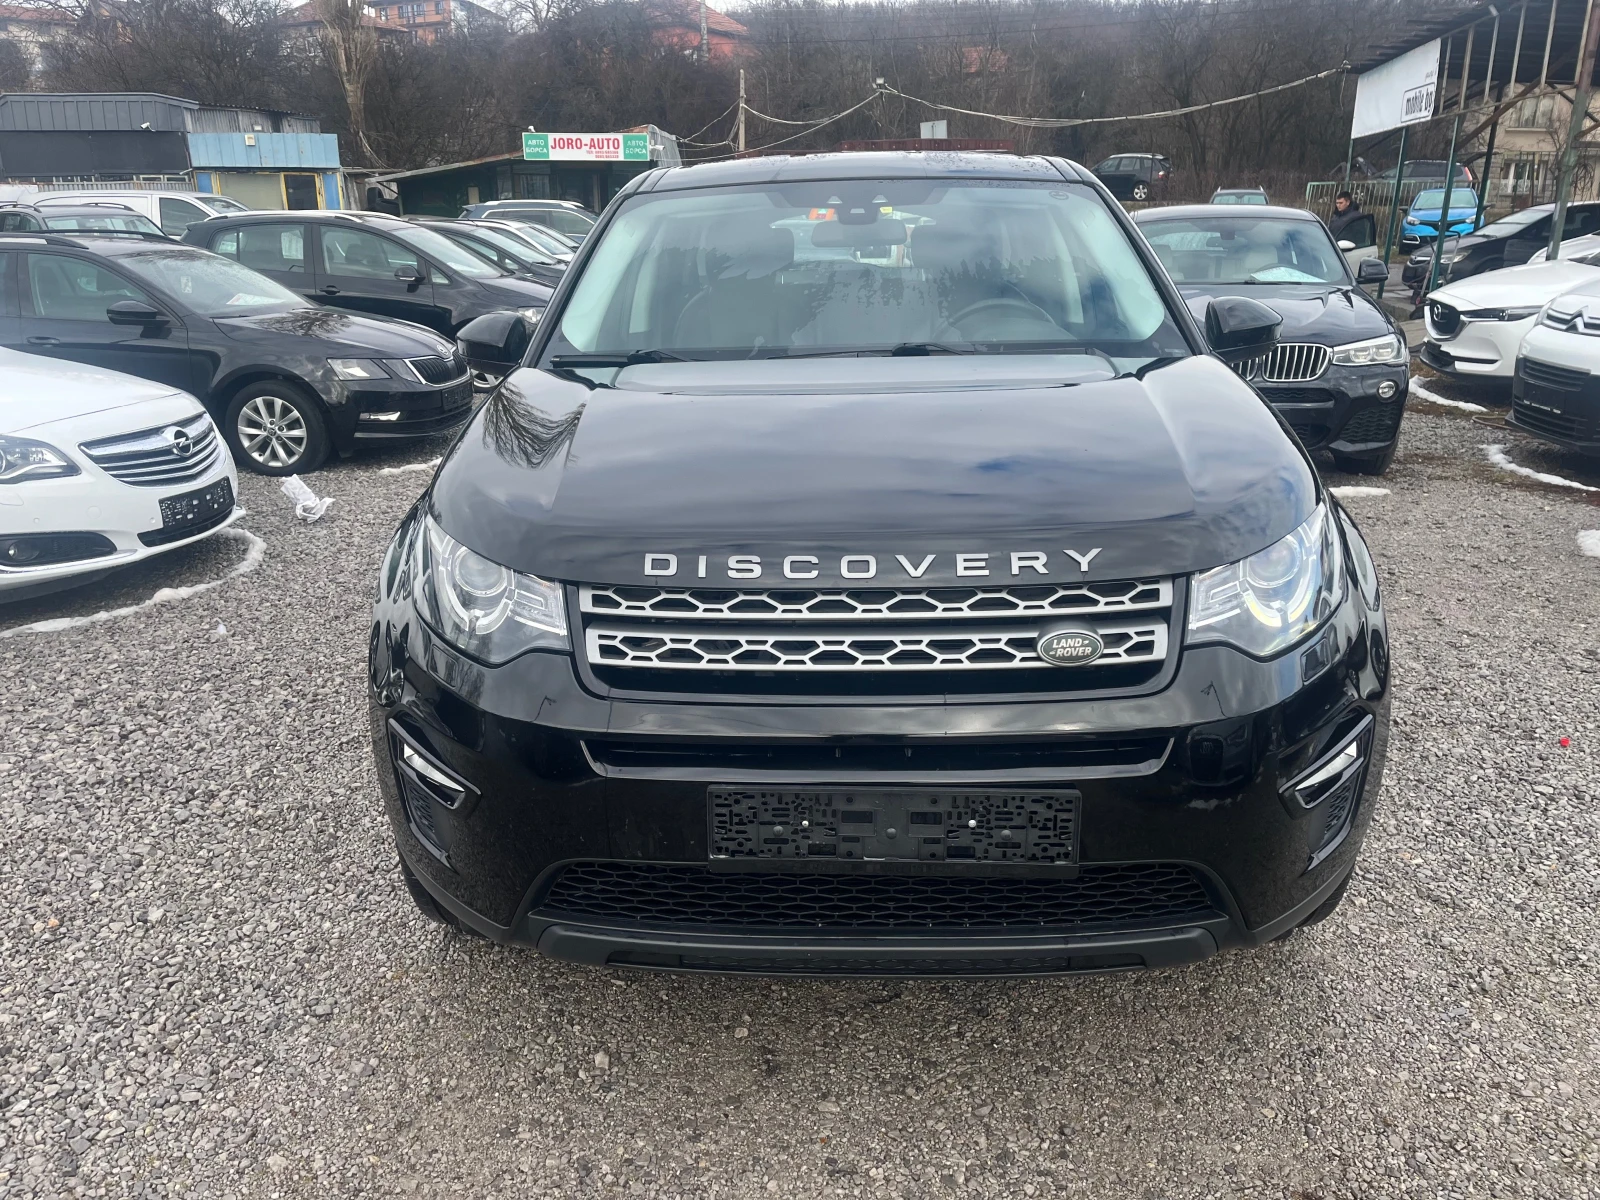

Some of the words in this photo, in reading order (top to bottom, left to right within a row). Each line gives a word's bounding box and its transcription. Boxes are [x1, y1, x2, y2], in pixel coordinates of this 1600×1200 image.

[550, 137, 621, 150] JORO-AUTO
[643, 547, 1103, 579] DISCOVERY
[1052, 638, 1083, 648] LAND
[1056, 646, 1092, 657] ROVER
